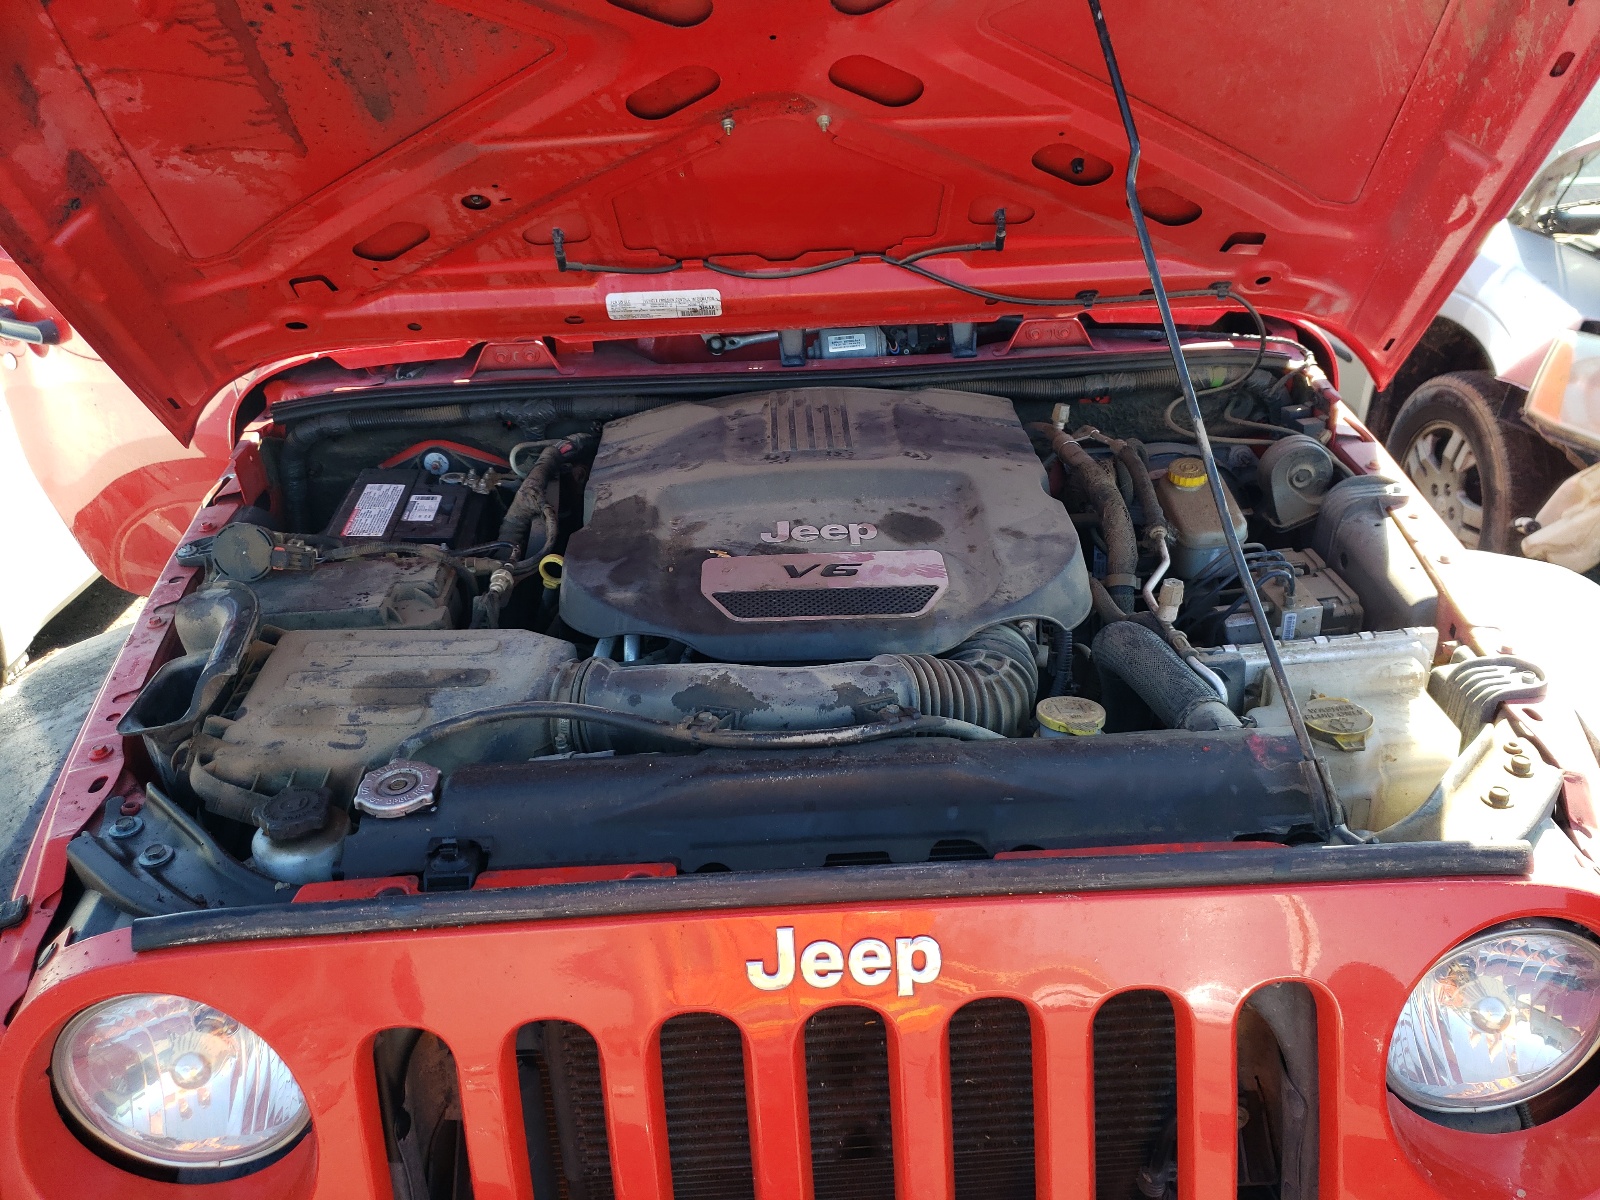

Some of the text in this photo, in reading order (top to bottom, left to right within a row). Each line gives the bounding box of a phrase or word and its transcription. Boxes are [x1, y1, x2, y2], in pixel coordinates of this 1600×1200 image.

[760, 520, 878, 545] Jeep
[782, 562, 863, 579] V6
[745, 925, 943, 997] Jeep
